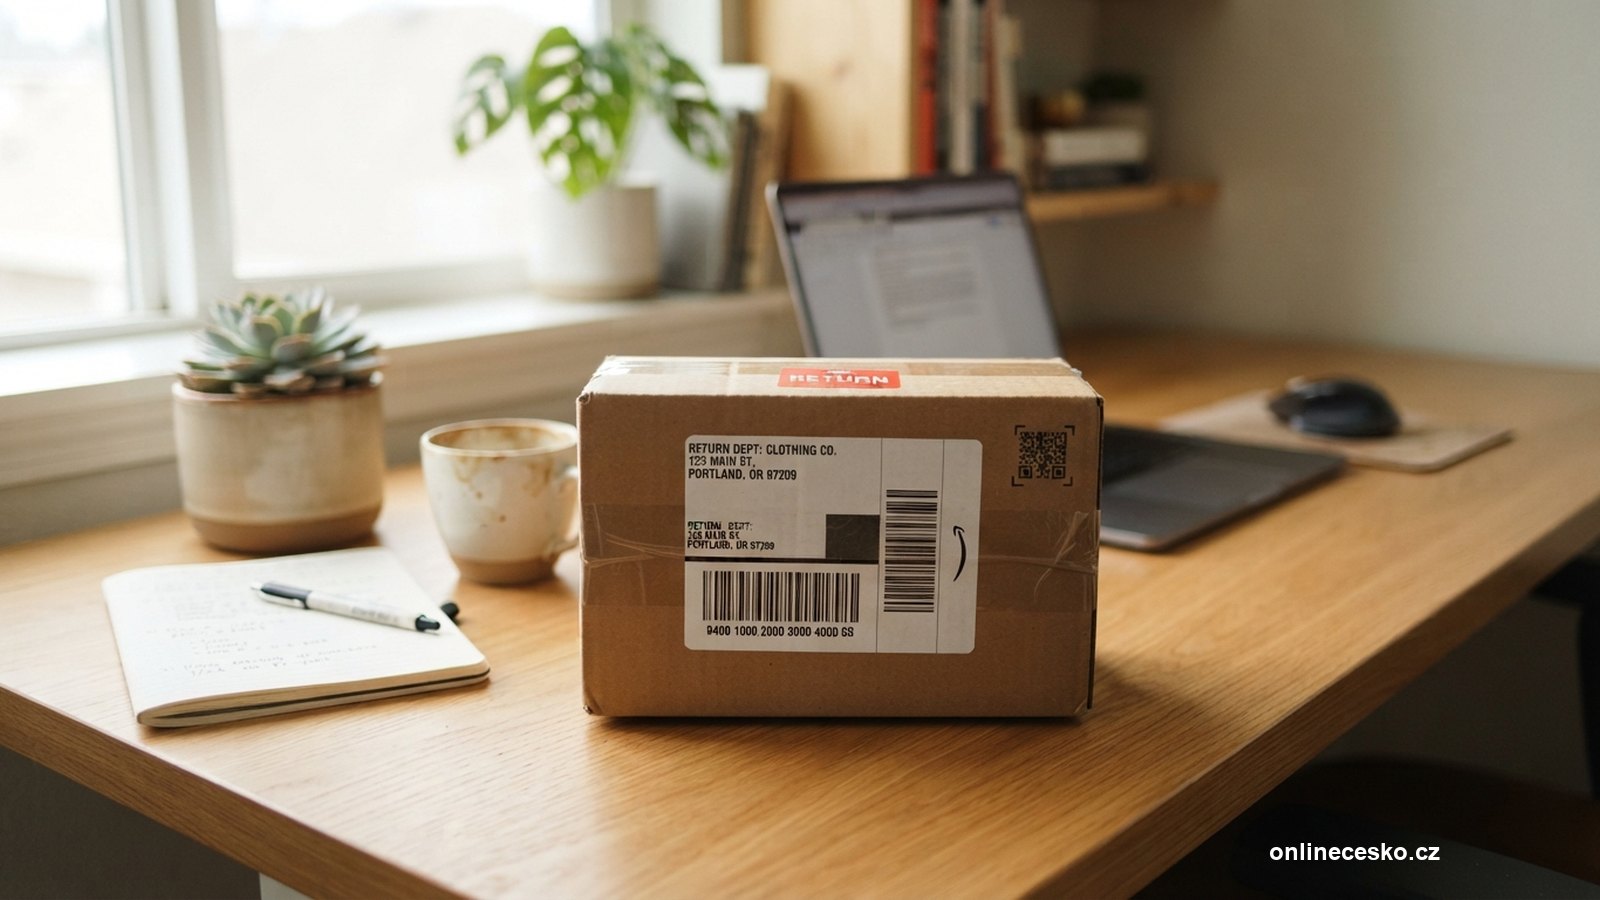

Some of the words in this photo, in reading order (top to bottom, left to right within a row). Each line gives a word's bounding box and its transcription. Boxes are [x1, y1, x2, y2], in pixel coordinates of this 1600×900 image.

[733, 443, 763, 455] DEPT:
[766, 443, 817, 456] CLOTHING
[820, 445, 837, 456] CO.
[689, 455, 707, 466] 123
[710, 456, 737, 466] MAIN
[749, 469, 764, 480] OR
[706, 625, 731, 636] 9400
[760, 626, 785, 637] 2000
[787, 626, 812, 637] 3000
